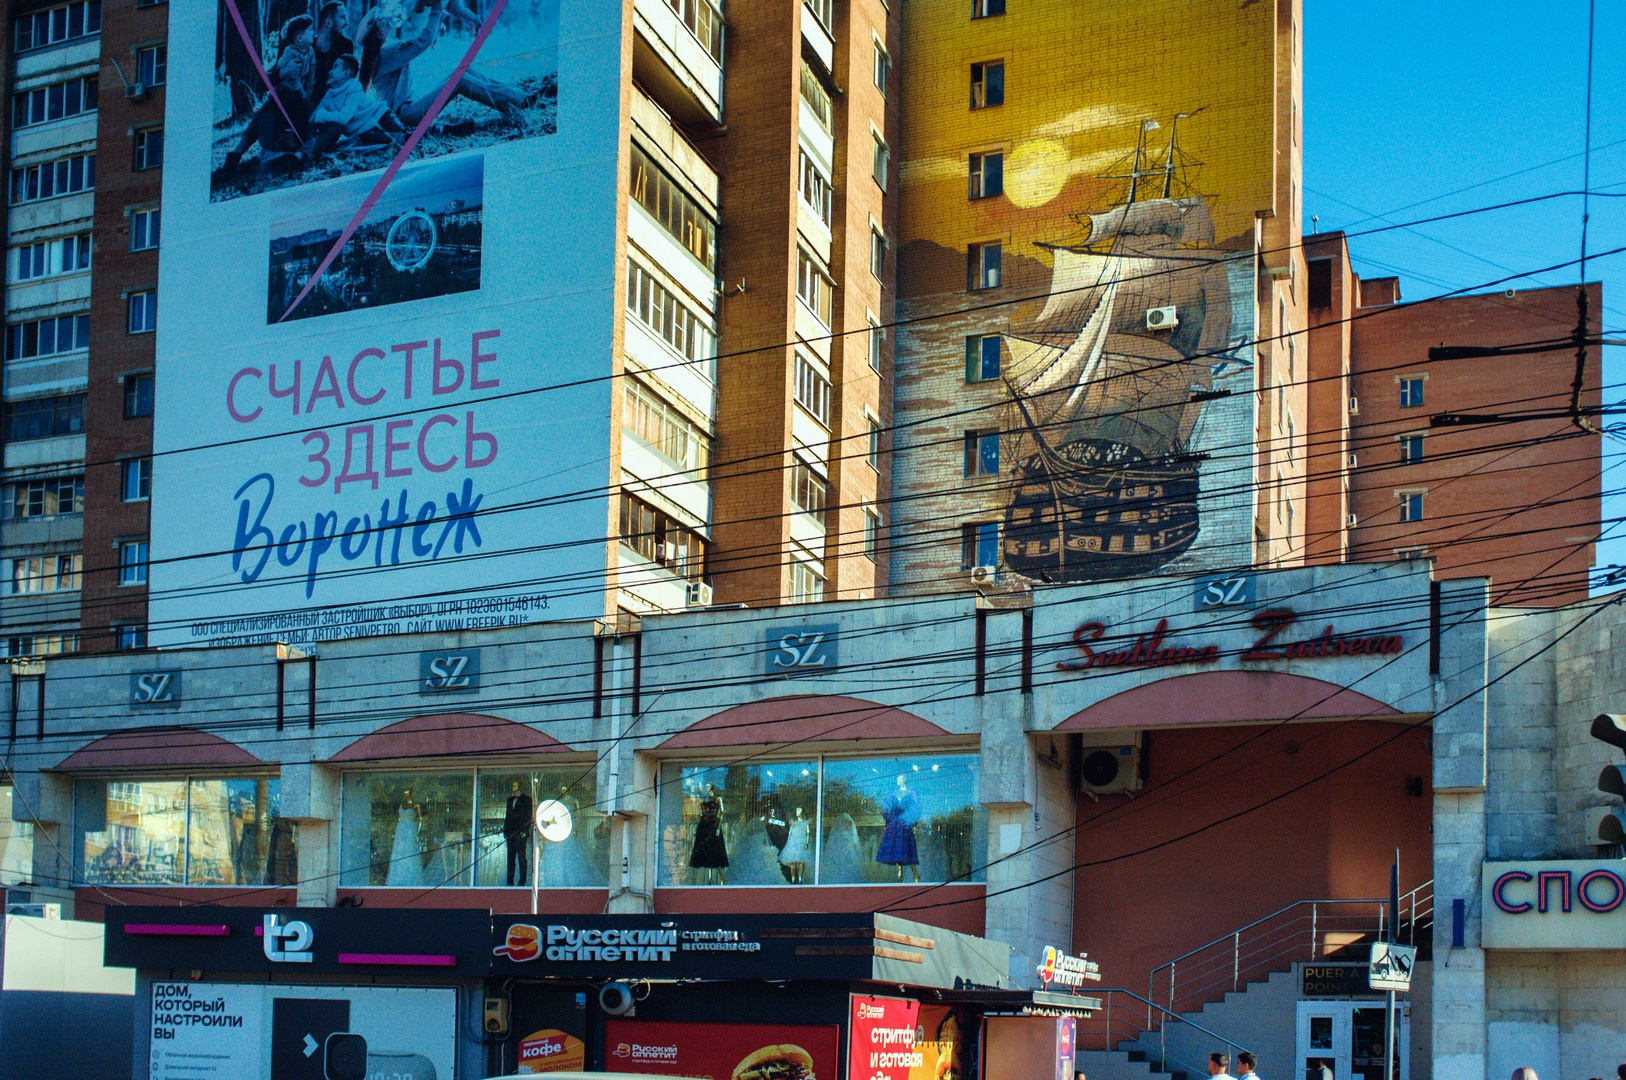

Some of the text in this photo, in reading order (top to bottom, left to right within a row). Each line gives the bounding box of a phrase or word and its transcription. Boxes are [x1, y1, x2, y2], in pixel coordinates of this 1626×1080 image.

[226, 329, 501, 423] СЧАСТЬЕ
[299, 411, 498, 494] ЗДЕСЬ
[232, 473, 484, 600] Воронеж
[1202, 577, 1247, 606] SZ
[191, 622, 209, 637] ООО
[437, 601, 462, 616] ОГРН
[774, 632, 827, 667] SZ
[1056, 618, 1219, 671] Svetlana
[425, 656, 470, 687] SZ
[135, 673, 174, 702] SZ
[1492, 869, 1626, 915] СПО
[264, 914, 314, 963] t2
[546, 921, 679, 952] Русский
[546, 945, 678, 962] аппетит
[154, 985, 192, 999] ДОМ,
[154, 997, 225, 1012] КОТОРЫЙ
[154, 1013, 243, 1028] НАСТРОИЛИ
[154, 1027, 176, 1040] ВЫ
[522, 1043, 562, 1058] кофе
[632, 1044, 678, 1054] Русский
[871, 1024, 925, 1049] стритфуд
[632, 1051, 677, 1059] аппетит
[870, 1052, 923, 1068] и готовая
